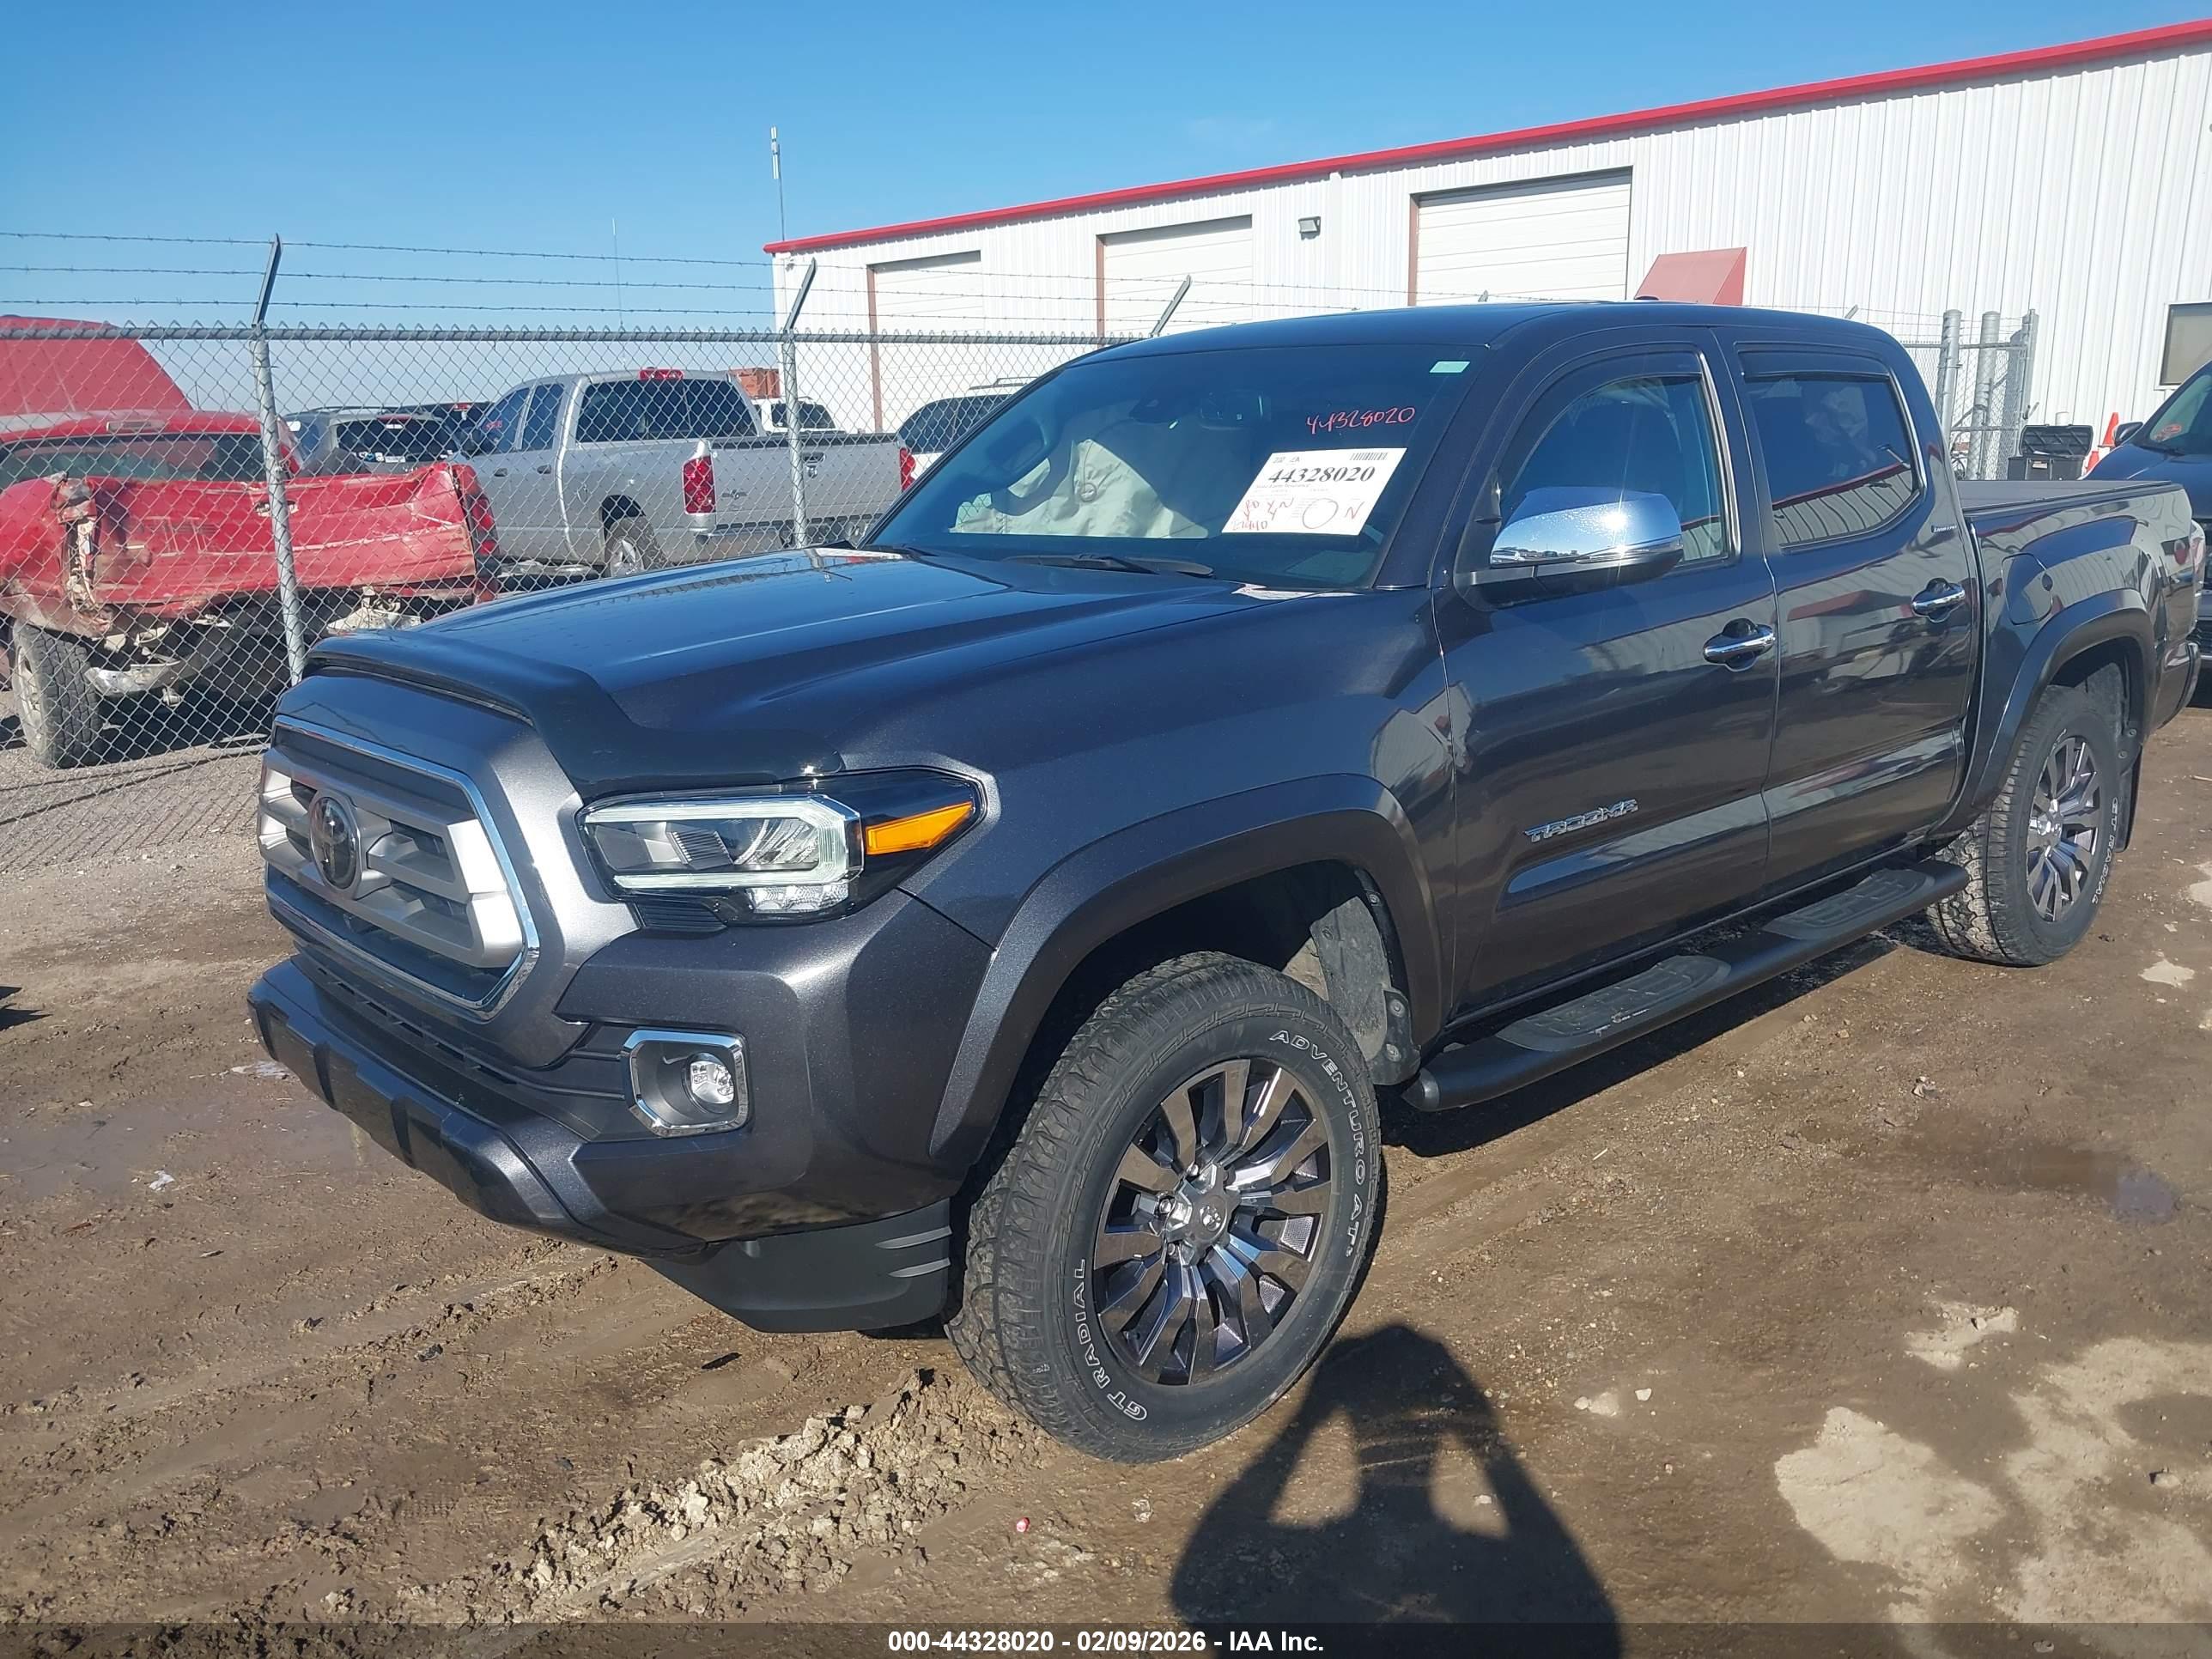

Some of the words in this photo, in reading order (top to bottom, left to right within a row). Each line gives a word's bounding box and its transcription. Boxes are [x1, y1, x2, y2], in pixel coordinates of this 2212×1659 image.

[1306, 406, 1416, 434] 44328020
[1267, 465, 1376, 483] 44328020
[1524, 798, 1639, 843] TACOMA
[2092, 835, 2115, 903] RADIAL
[1269, 1030, 1367, 1185] ADVENTURO
[1073, 1259, 1111, 1389] RADIAL
[1106, 1390, 1148, 1421] GT
